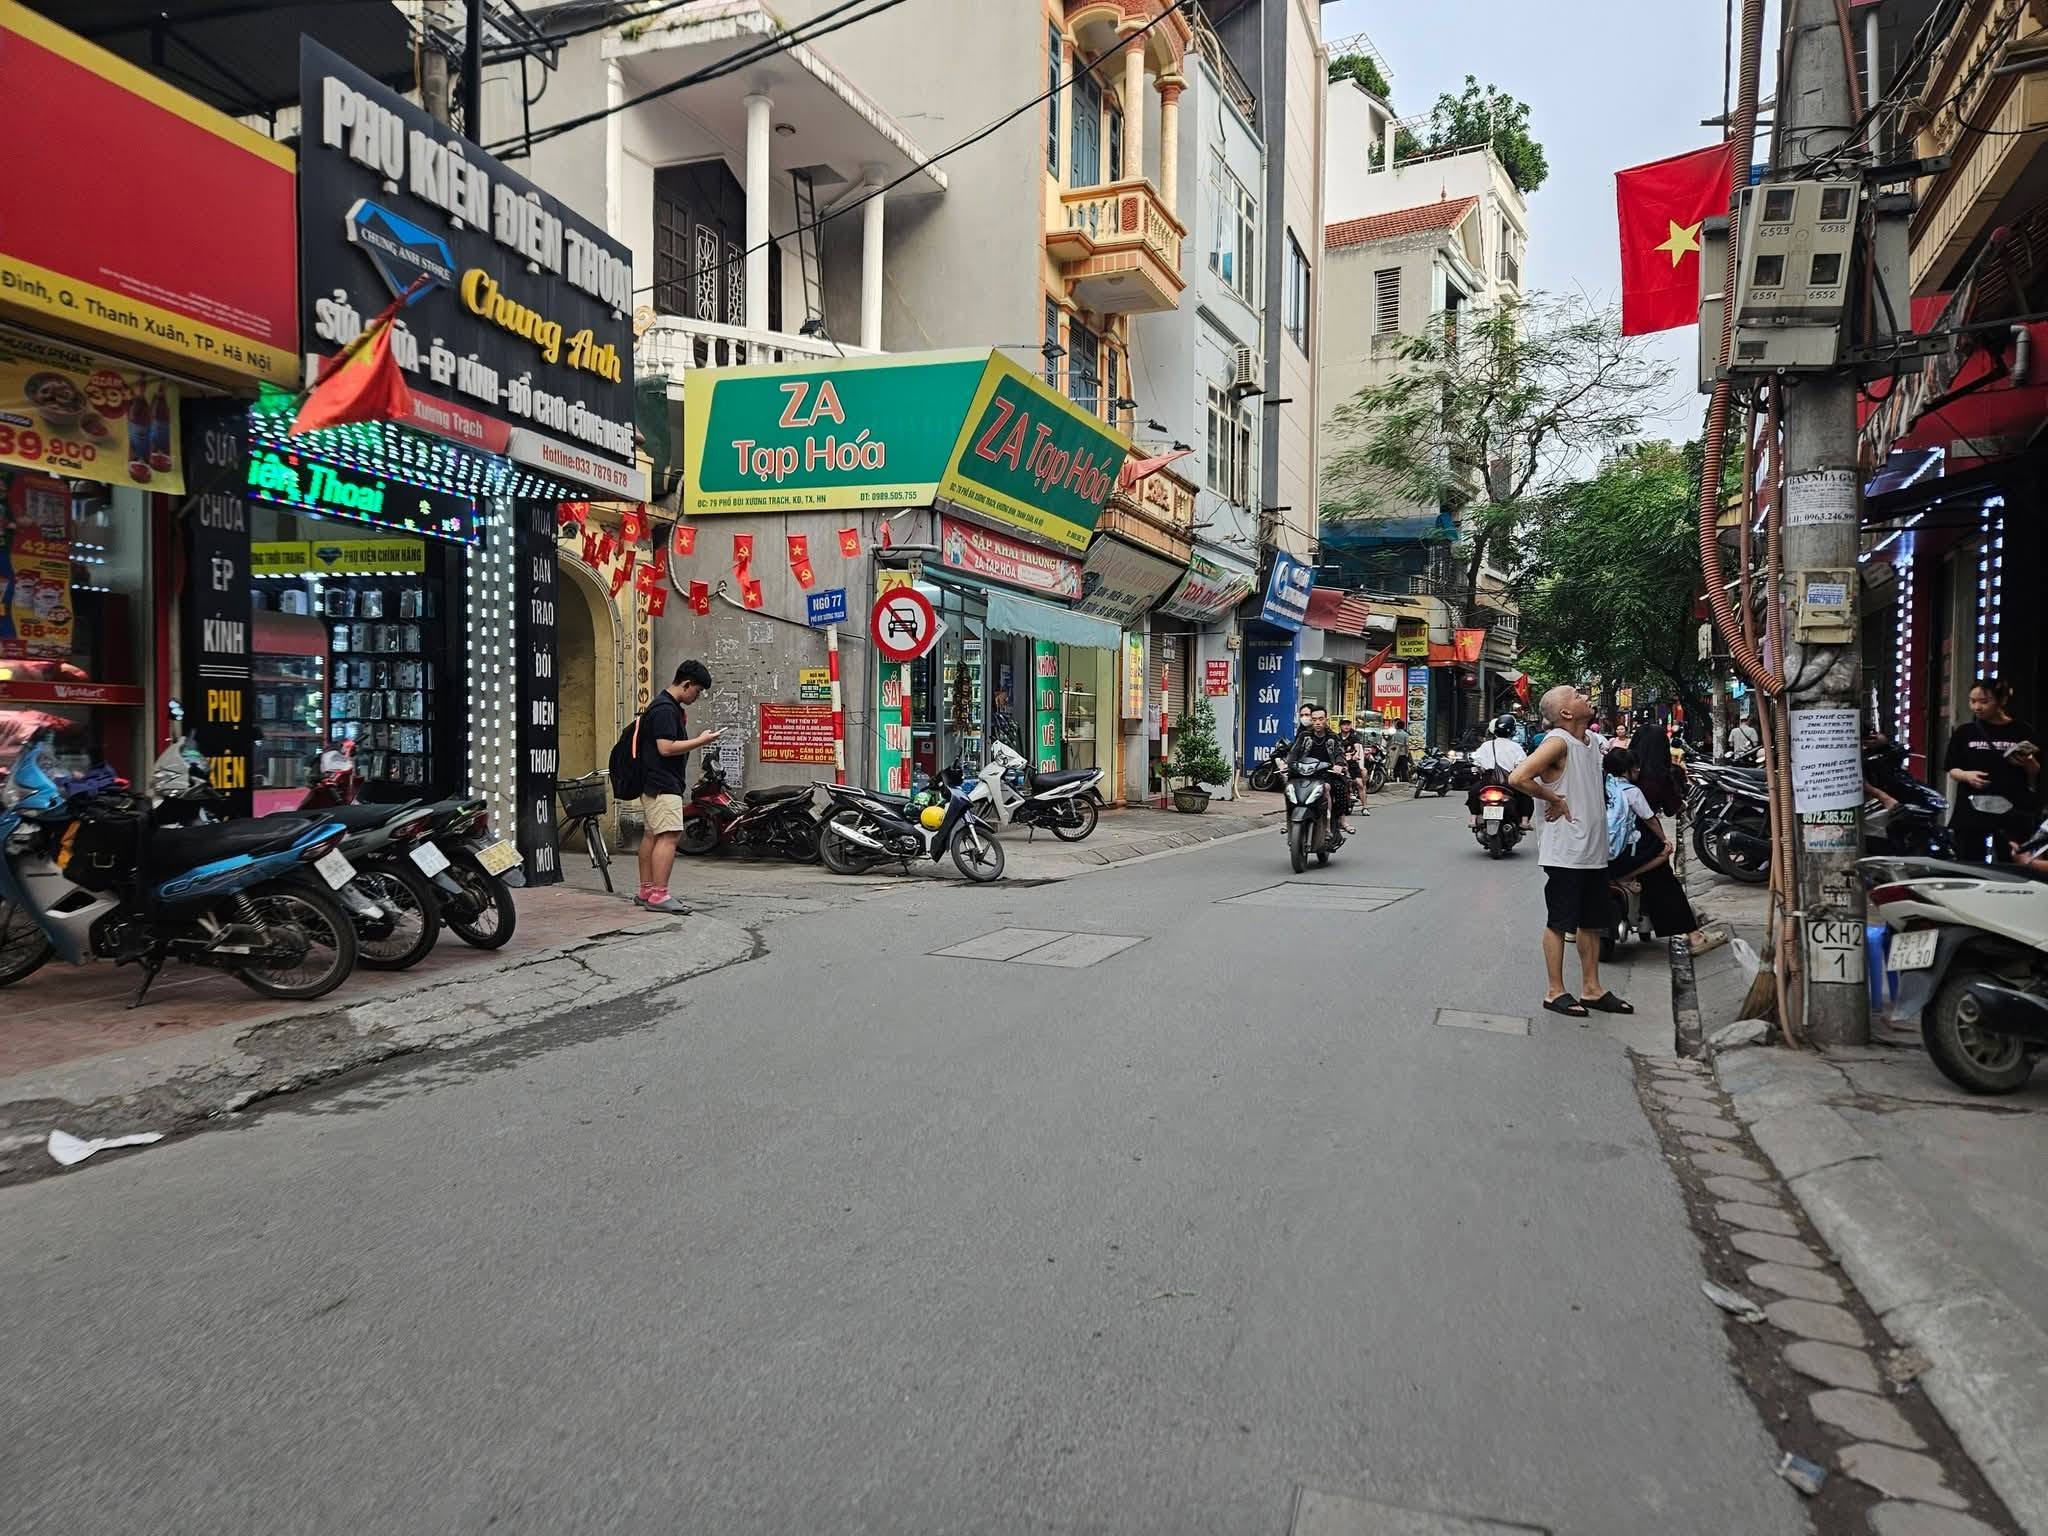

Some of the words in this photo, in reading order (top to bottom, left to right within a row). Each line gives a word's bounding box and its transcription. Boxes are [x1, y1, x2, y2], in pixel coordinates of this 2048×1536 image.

[323, 76, 404, 194] PHỤ
[409, 130, 489, 233] KIỆN
[494, 183, 563, 275] ĐIỆN
[565, 228, 633, 321] THOẠI
[1761, 226, 1790, 237] 6529
[1820, 224, 1847, 233] 6538
[360, 229, 397, 257] CHUNG
[399, 243, 420, 266] ANH
[421, 255, 452, 281] STORE
[1809, 290, 1837, 300] 6552
[1, 270, 53, 304] Đình,
[58, 290, 79, 309] Q.
[86, 297, 139, 329] Thanh
[144, 316, 189, 347] Xuân,
[194, 333, 219, 354] TP.
[222, 343, 242, 361] Hà
[248, 351, 272, 376] Nội
[461, 267, 562, 364] Chung
[565, 329, 621, 384] Anh
[315, 288, 361, 352] SỬA
[430, 337, 456, 387] ÉP
[457, 354, 498, 406] KÍNH
[508, 371, 532, 418] ĐỒ
[778, 380, 846, 428] ZA
[452, 410, 483, 439] Trạch
[732, 439, 798, 484] Tạp
[805, 429, 886, 472] Hóa
[974, 396, 1029, 471] ZA
[1024, 423, 1069, 491] Tạp
[1067, 446, 1112, 505] Hóa
[592, 462, 612, 482] 7879
[613, 470, 628, 487] 678
[304, 463, 386, 521] Thoại
[200, 490, 245, 532] CHỮA
[994, 542, 1018, 560] KHAI
[211, 550, 235, 592] ÉP
[832, 594, 842, 607] 77
[203, 613, 244, 653] KÍNH
[1258, 654, 1283, 674] GIẶT
[1041, 690, 1055, 711] LO
[1258, 683, 1281, 704] SẤY
[207, 690, 241, 730] PHỤ
[532, 698, 554, 732] ĐIỆN
[1259, 714, 1280, 734] LẤY
[530, 747, 556, 779] THOẠI
[1254, 746, 1276, 761] NGA
[534, 844, 553, 873] MỚI
[1811, 923, 1863, 946] CKH2
[1834, 952, 1846, 979] 1
